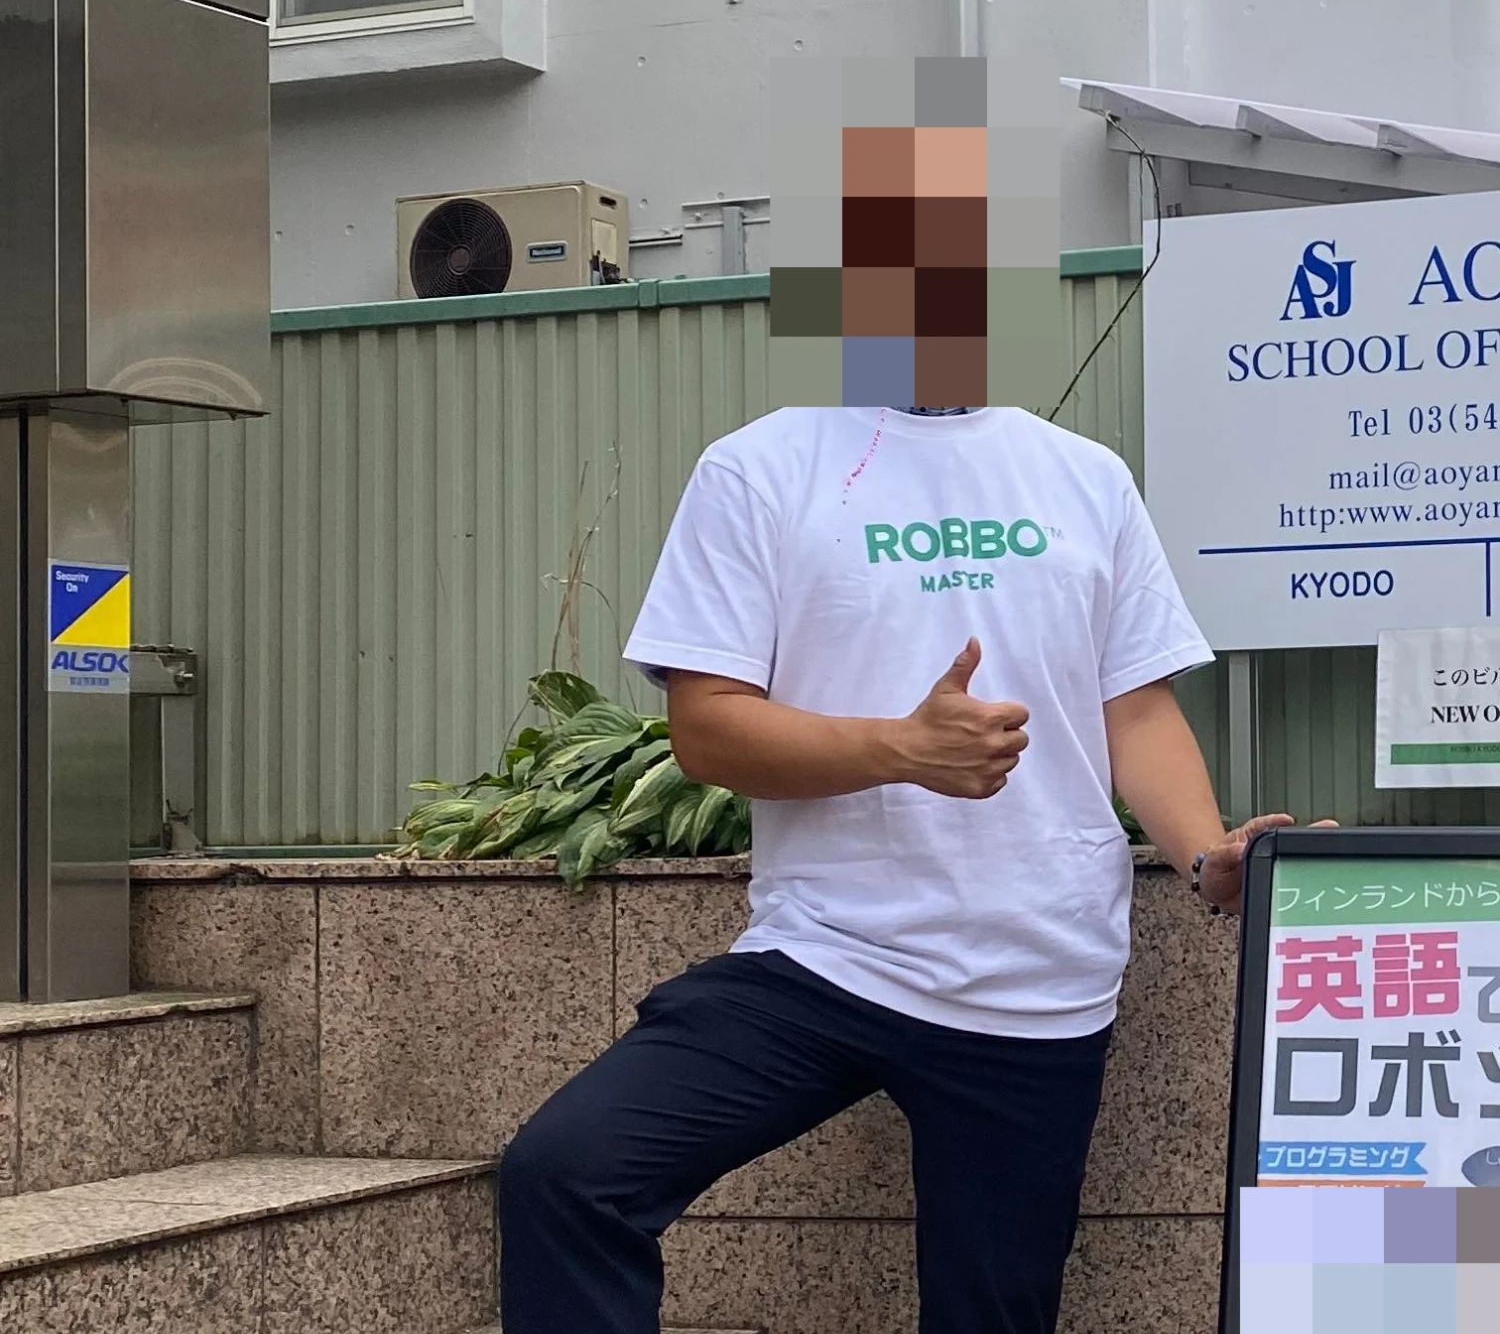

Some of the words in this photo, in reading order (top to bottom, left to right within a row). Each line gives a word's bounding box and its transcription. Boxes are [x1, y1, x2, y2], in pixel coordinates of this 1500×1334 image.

[1227, 334, 1424, 383] SCHOOL
[1436, 329, 1500, 370] OF
[1348, 407, 1391, 438] Tel
[56, 570, 89, 583] Security
[66, 582, 78, 593] On
[1290, 570, 1394, 601] KYODO
[51, 650, 130, 673] ALSOK
[1431, 705, 1479, 723] NEW
[1266, 1146, 1411, 1168] プログラミング
